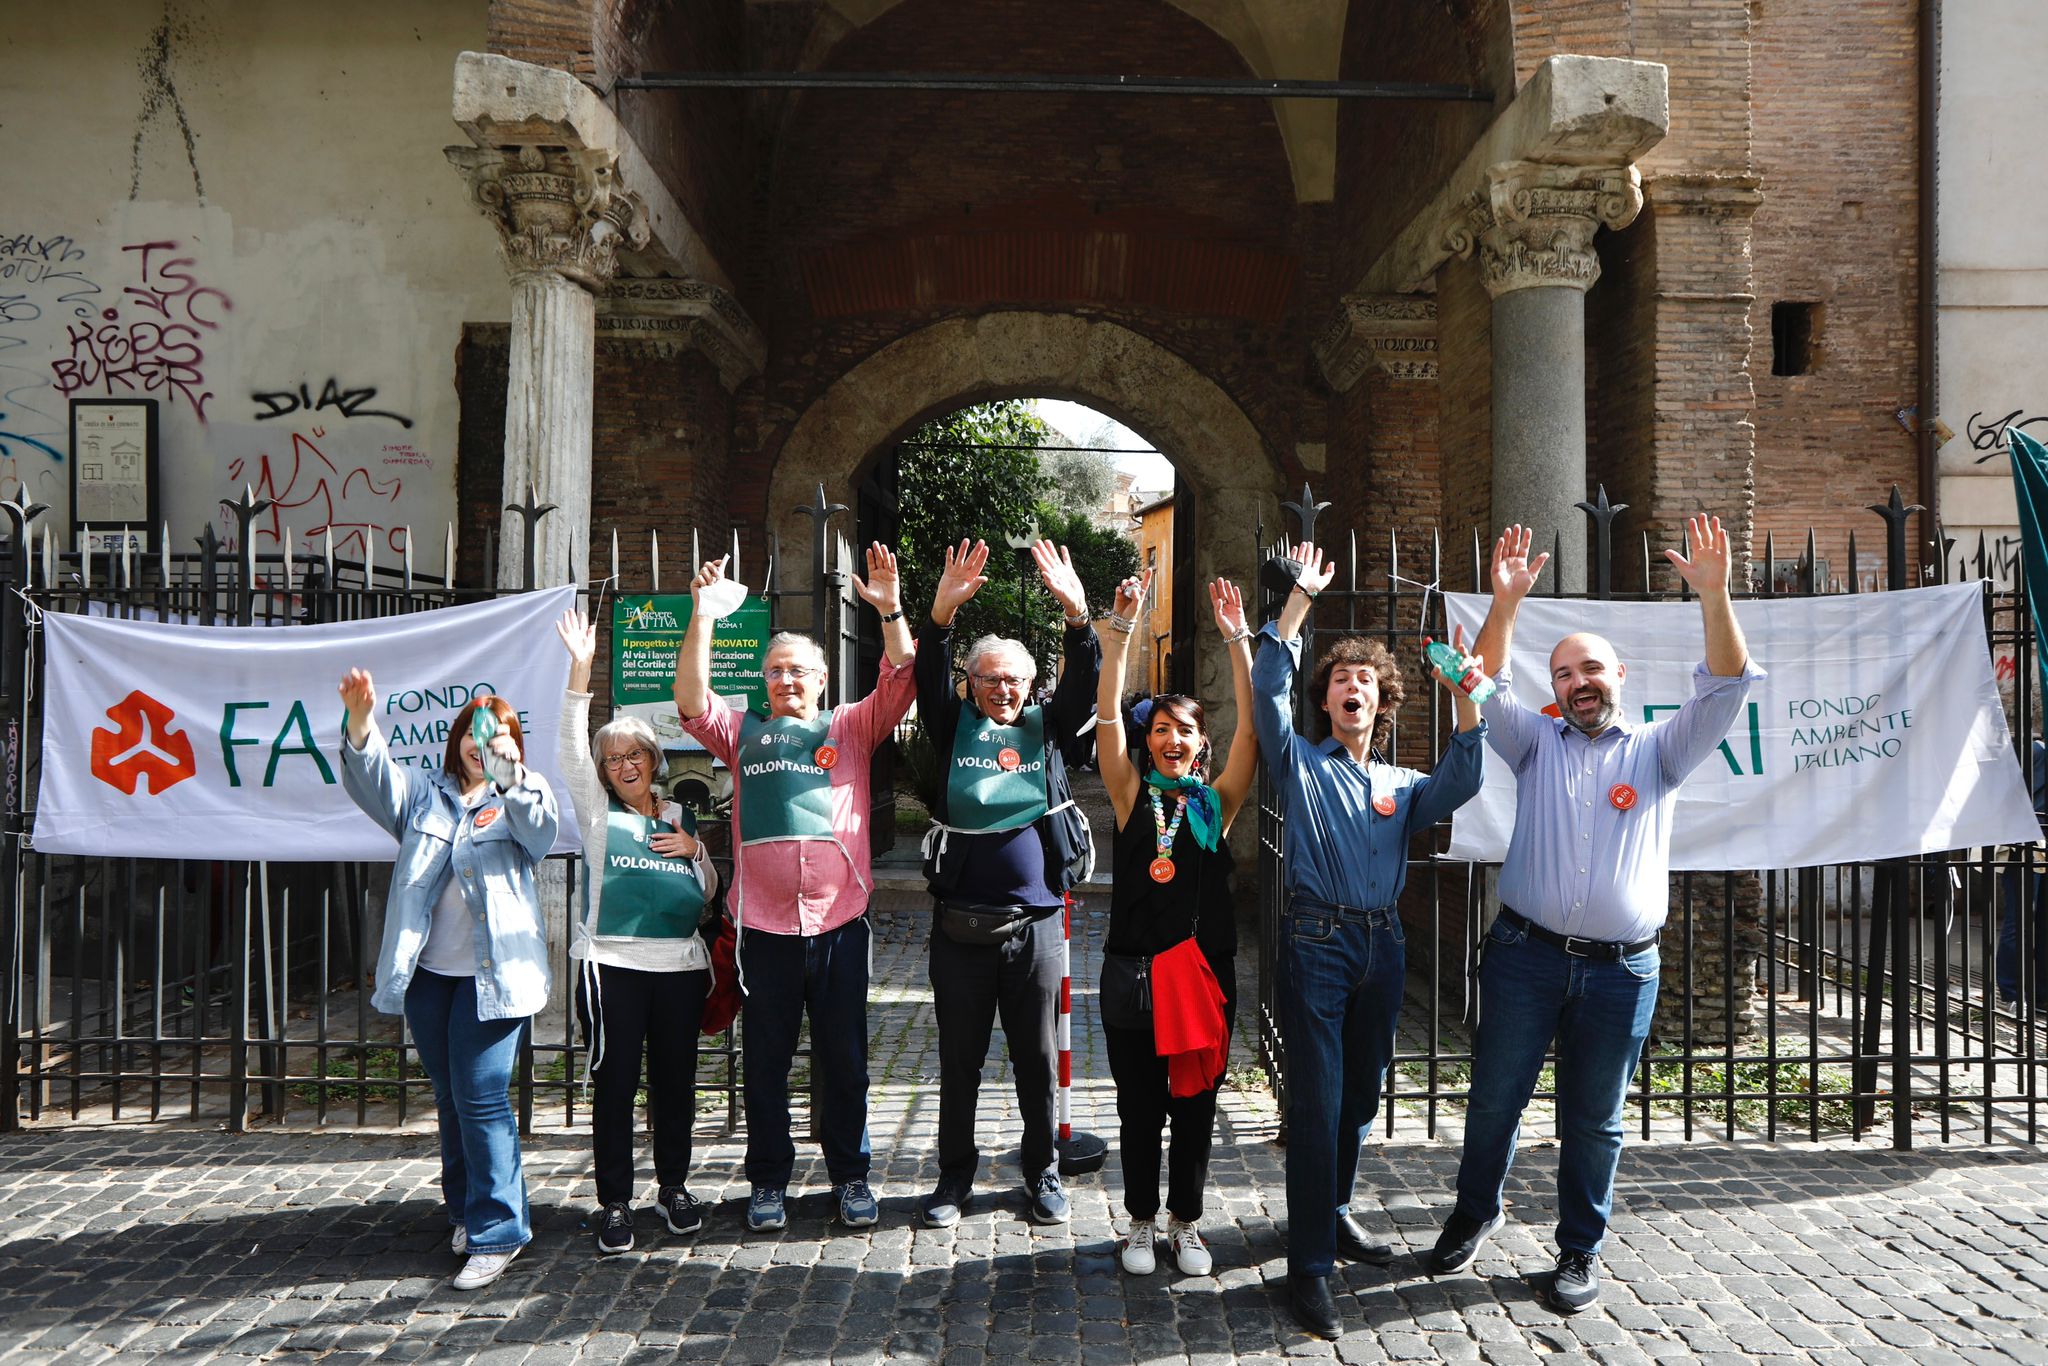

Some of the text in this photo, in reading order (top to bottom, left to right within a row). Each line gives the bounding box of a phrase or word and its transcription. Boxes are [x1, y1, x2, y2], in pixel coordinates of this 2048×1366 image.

[251, 377, 413, 429] DIAZ
[623, 638, 629, 647] Il
[630, 639, 667, 649] progetto
[669, 638, 675, 647] è
[711, 639, 758, 648] PROVATO!
[623, 651, 632, 660] Al
[633, 651, 646, 660] via
[652, 651, 677, 660] lavori
[622, 660, 636, 669] del
[637, 660, 666, 669] Cortile
[667, 660, 676, 669] di
[622, 670, 637, 679] per
[638, 670, 665, 678] creare
[665, 670, 676, 678] un
[728, 670, 734, 678] e
[734, 668, 764, 678] cultura
[1788, 694, 1881, 720] FONDO
[219, 700, 348, 787] FA
[773, 733, 789, 744] FAI
[991, 733, 1007, 746] FAI
[1794, 738, 1902, 774] ITALIANO
[743, 759, 825, 777] VOLONTARIO
